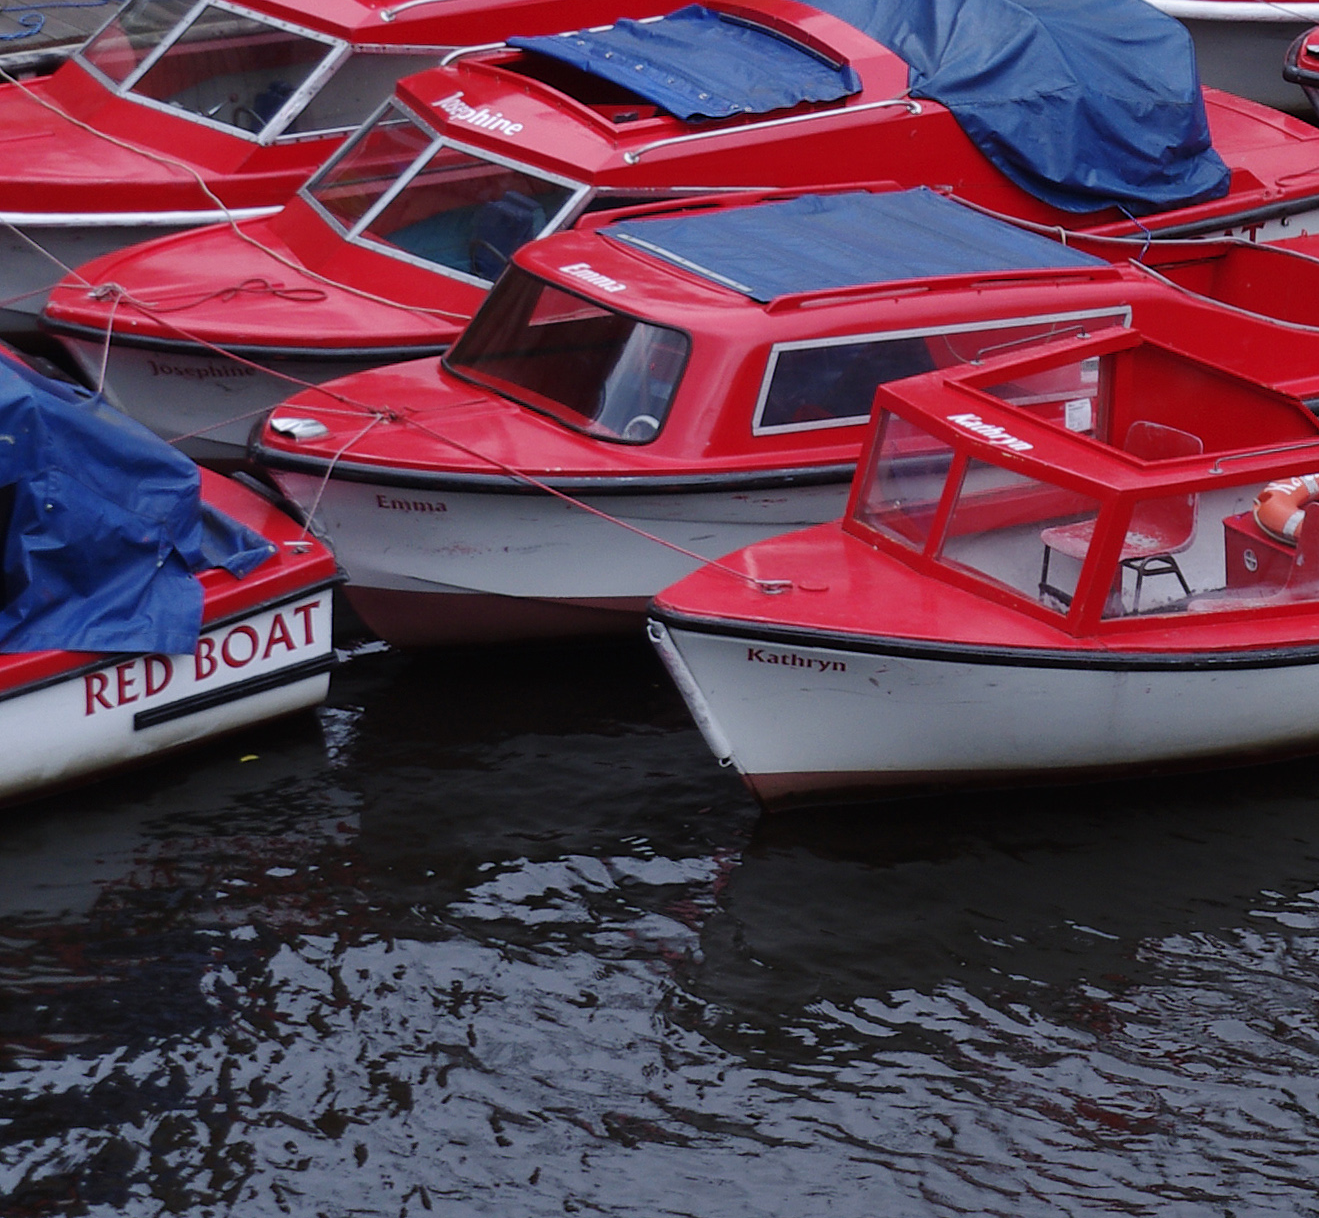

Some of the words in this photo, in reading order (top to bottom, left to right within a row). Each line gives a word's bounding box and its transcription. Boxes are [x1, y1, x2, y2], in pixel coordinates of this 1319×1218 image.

[431, 91, 524, 136] Josephine
[558, 262, 627, 293] Emma
[147, 359, 256, 380] Josephine
[946, 413, 1034, 451] Kathryn
[375, 494, 447, 512] Emma
[85, 653, 173, 716] RED
[195, 600, 321, 682] BOAT
[747, 648, 846, 672] Kathryn
